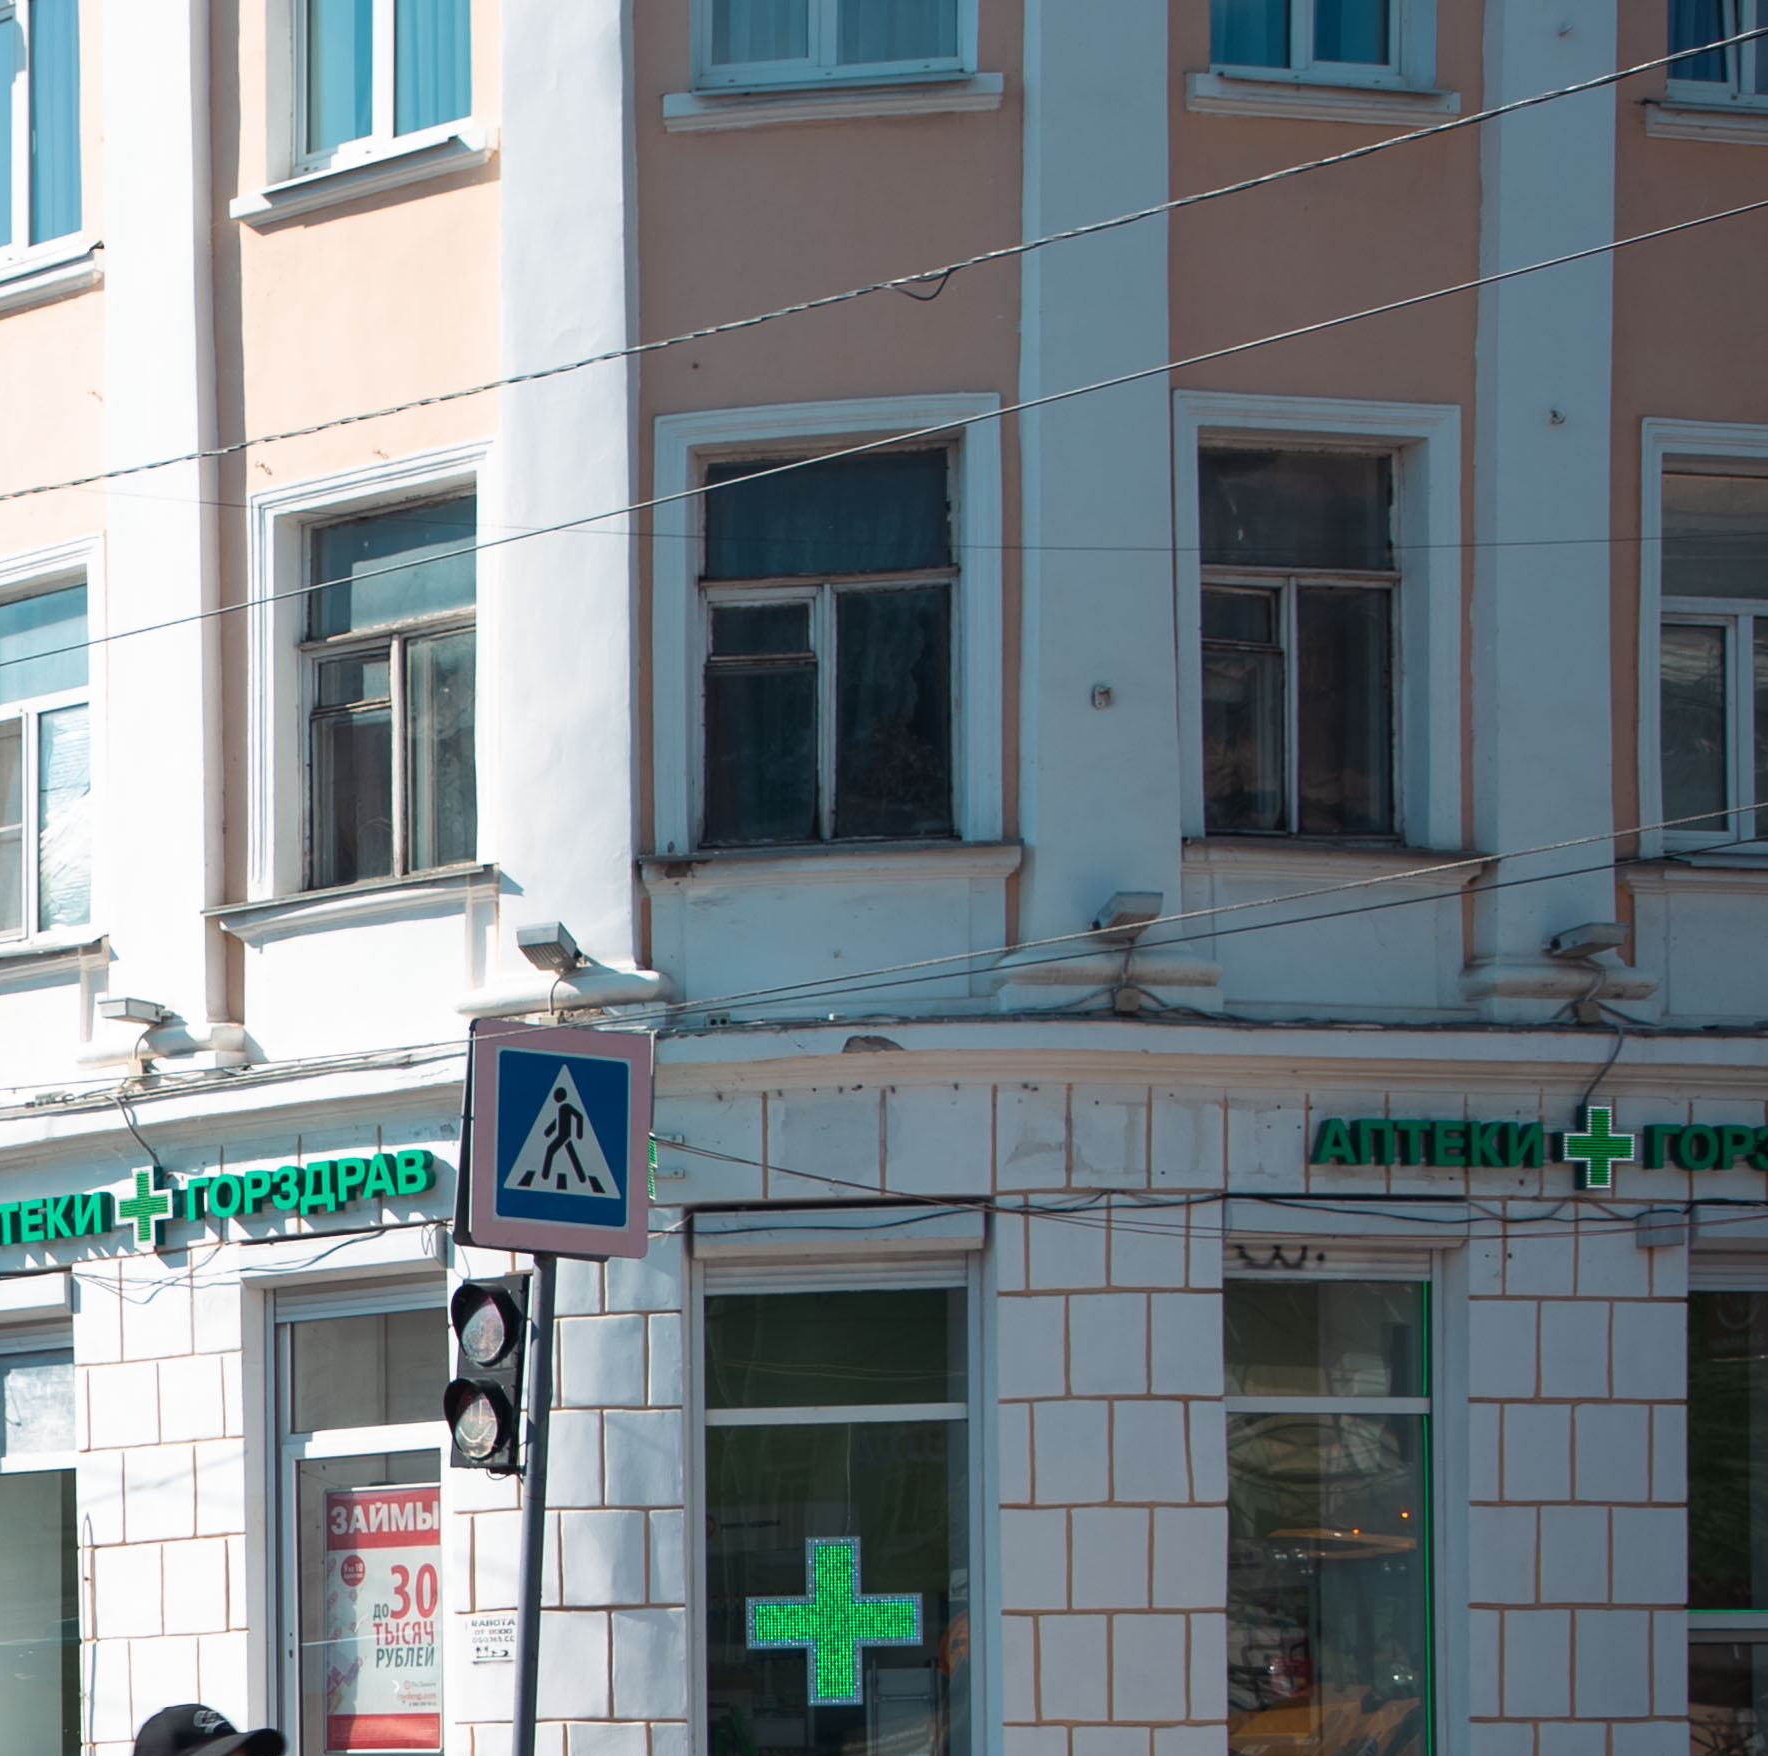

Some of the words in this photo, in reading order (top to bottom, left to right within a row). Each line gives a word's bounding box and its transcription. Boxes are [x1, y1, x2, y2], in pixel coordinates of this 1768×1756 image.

[1310, 1117, 1545, 1168] АПТЕКИ
[186, 1148, 438, 1222] ГОРЗДРАВ
[330, 1501, 439, 1535] ЗАЙМЫ
[390, 1563, 439, 1619] 30
[373, 1621, 435, 1646] ТЫСЯЧ
[375, 1643, 435, 1669] РУБЛЕЙ
